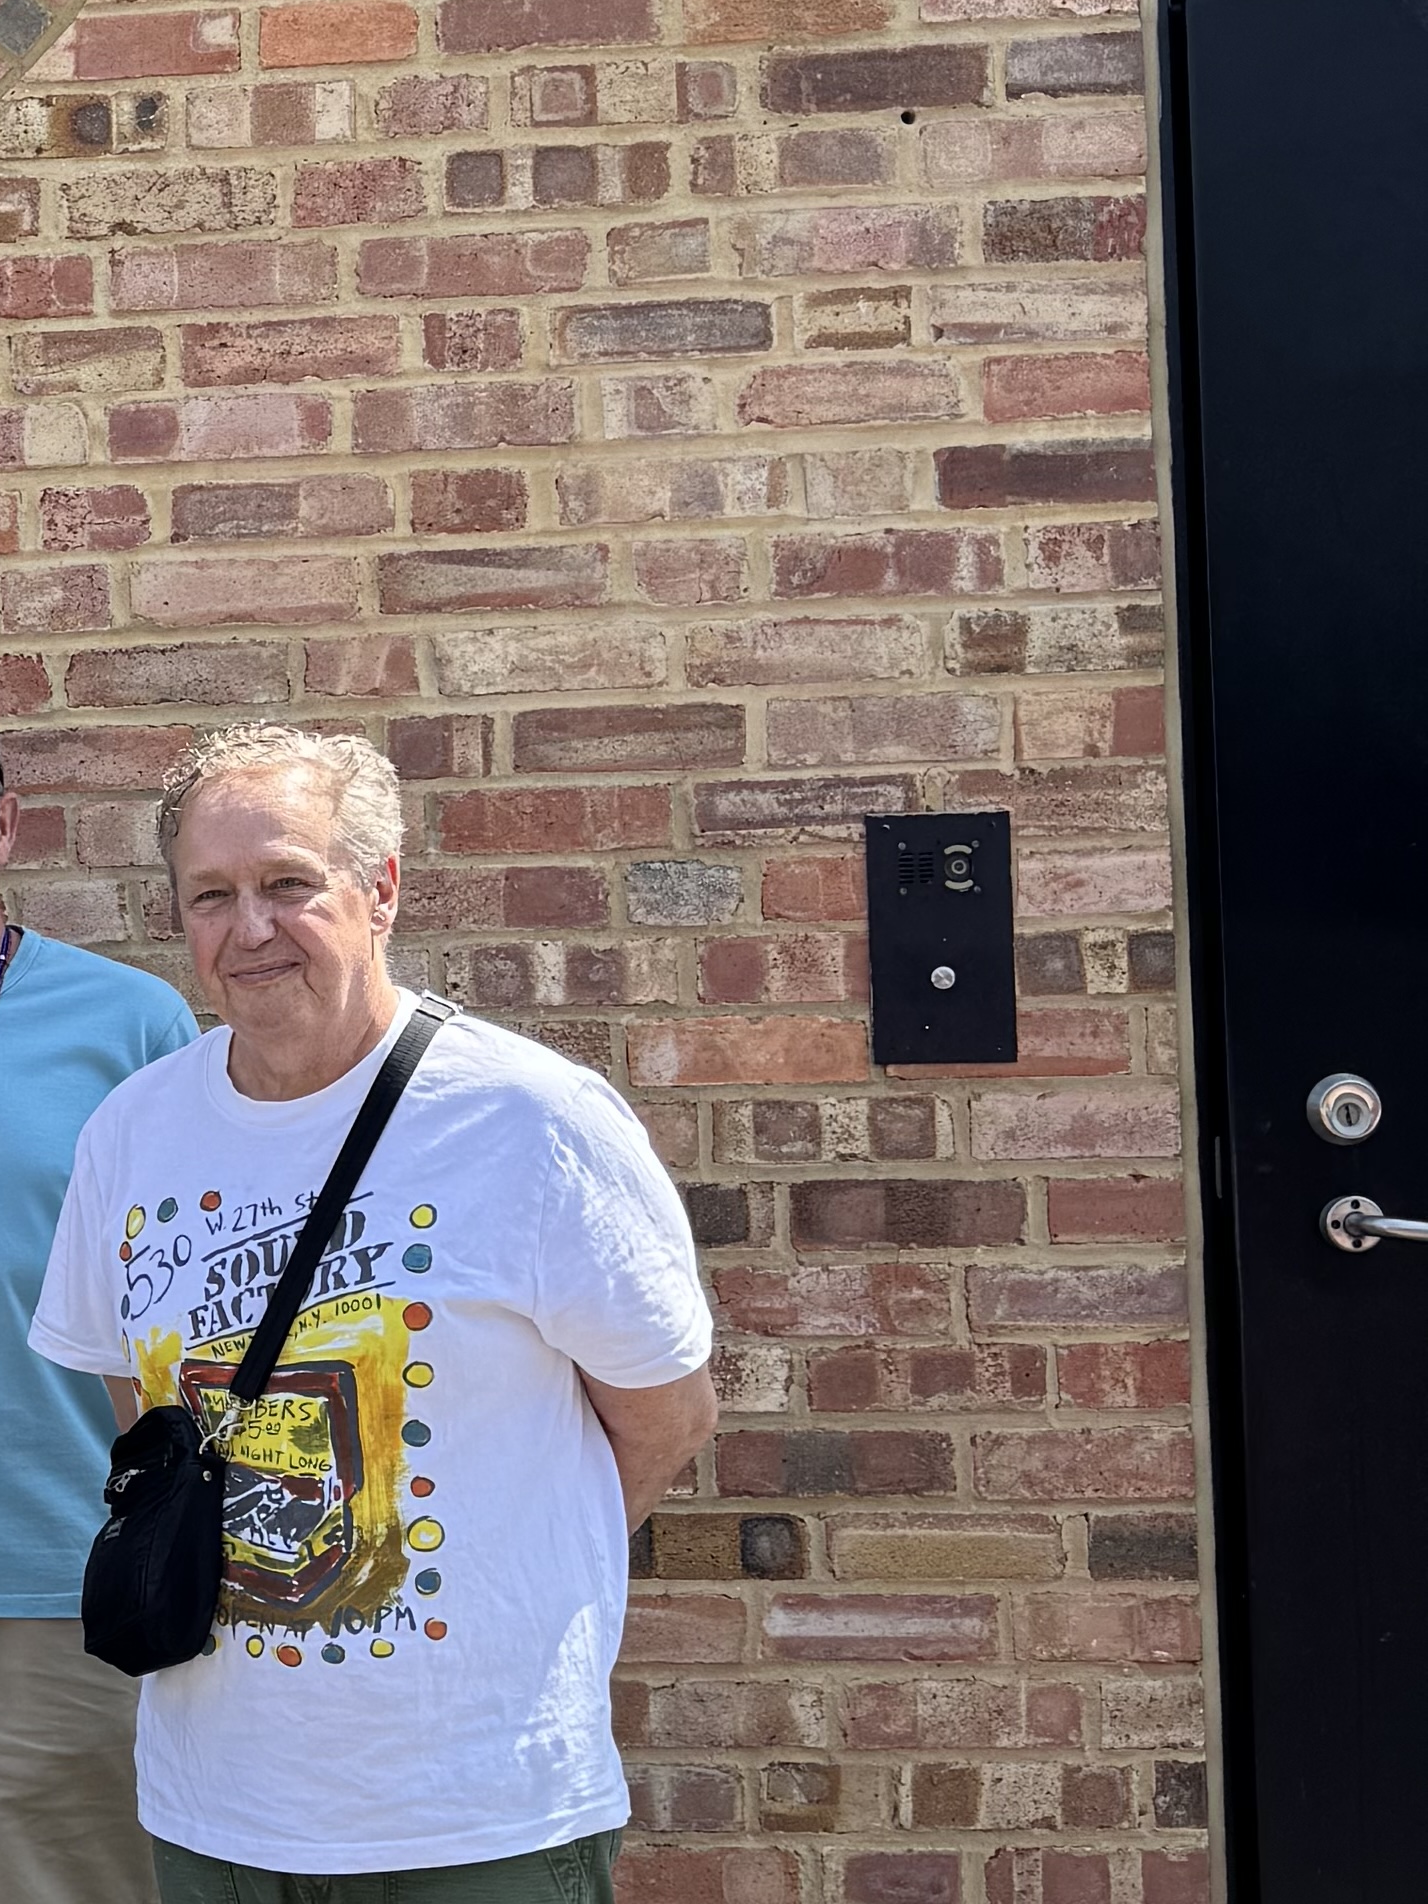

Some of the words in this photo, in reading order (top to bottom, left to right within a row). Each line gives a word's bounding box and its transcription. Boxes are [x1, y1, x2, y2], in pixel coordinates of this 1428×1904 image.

[232, 1197, 282, 1232] 27th
[125, 1234, 192, 1321] 530
[204, 1209, 367, 1302] SOUD
[189, 1241, 395, 1341] FACTRY
[211, 1336, 246, 1359] NEW
[335, 1293, 382, 1317] 10001
[211, 1393, 314, 1421] MBERS
[289, 1455, 332, 1472] LONG
